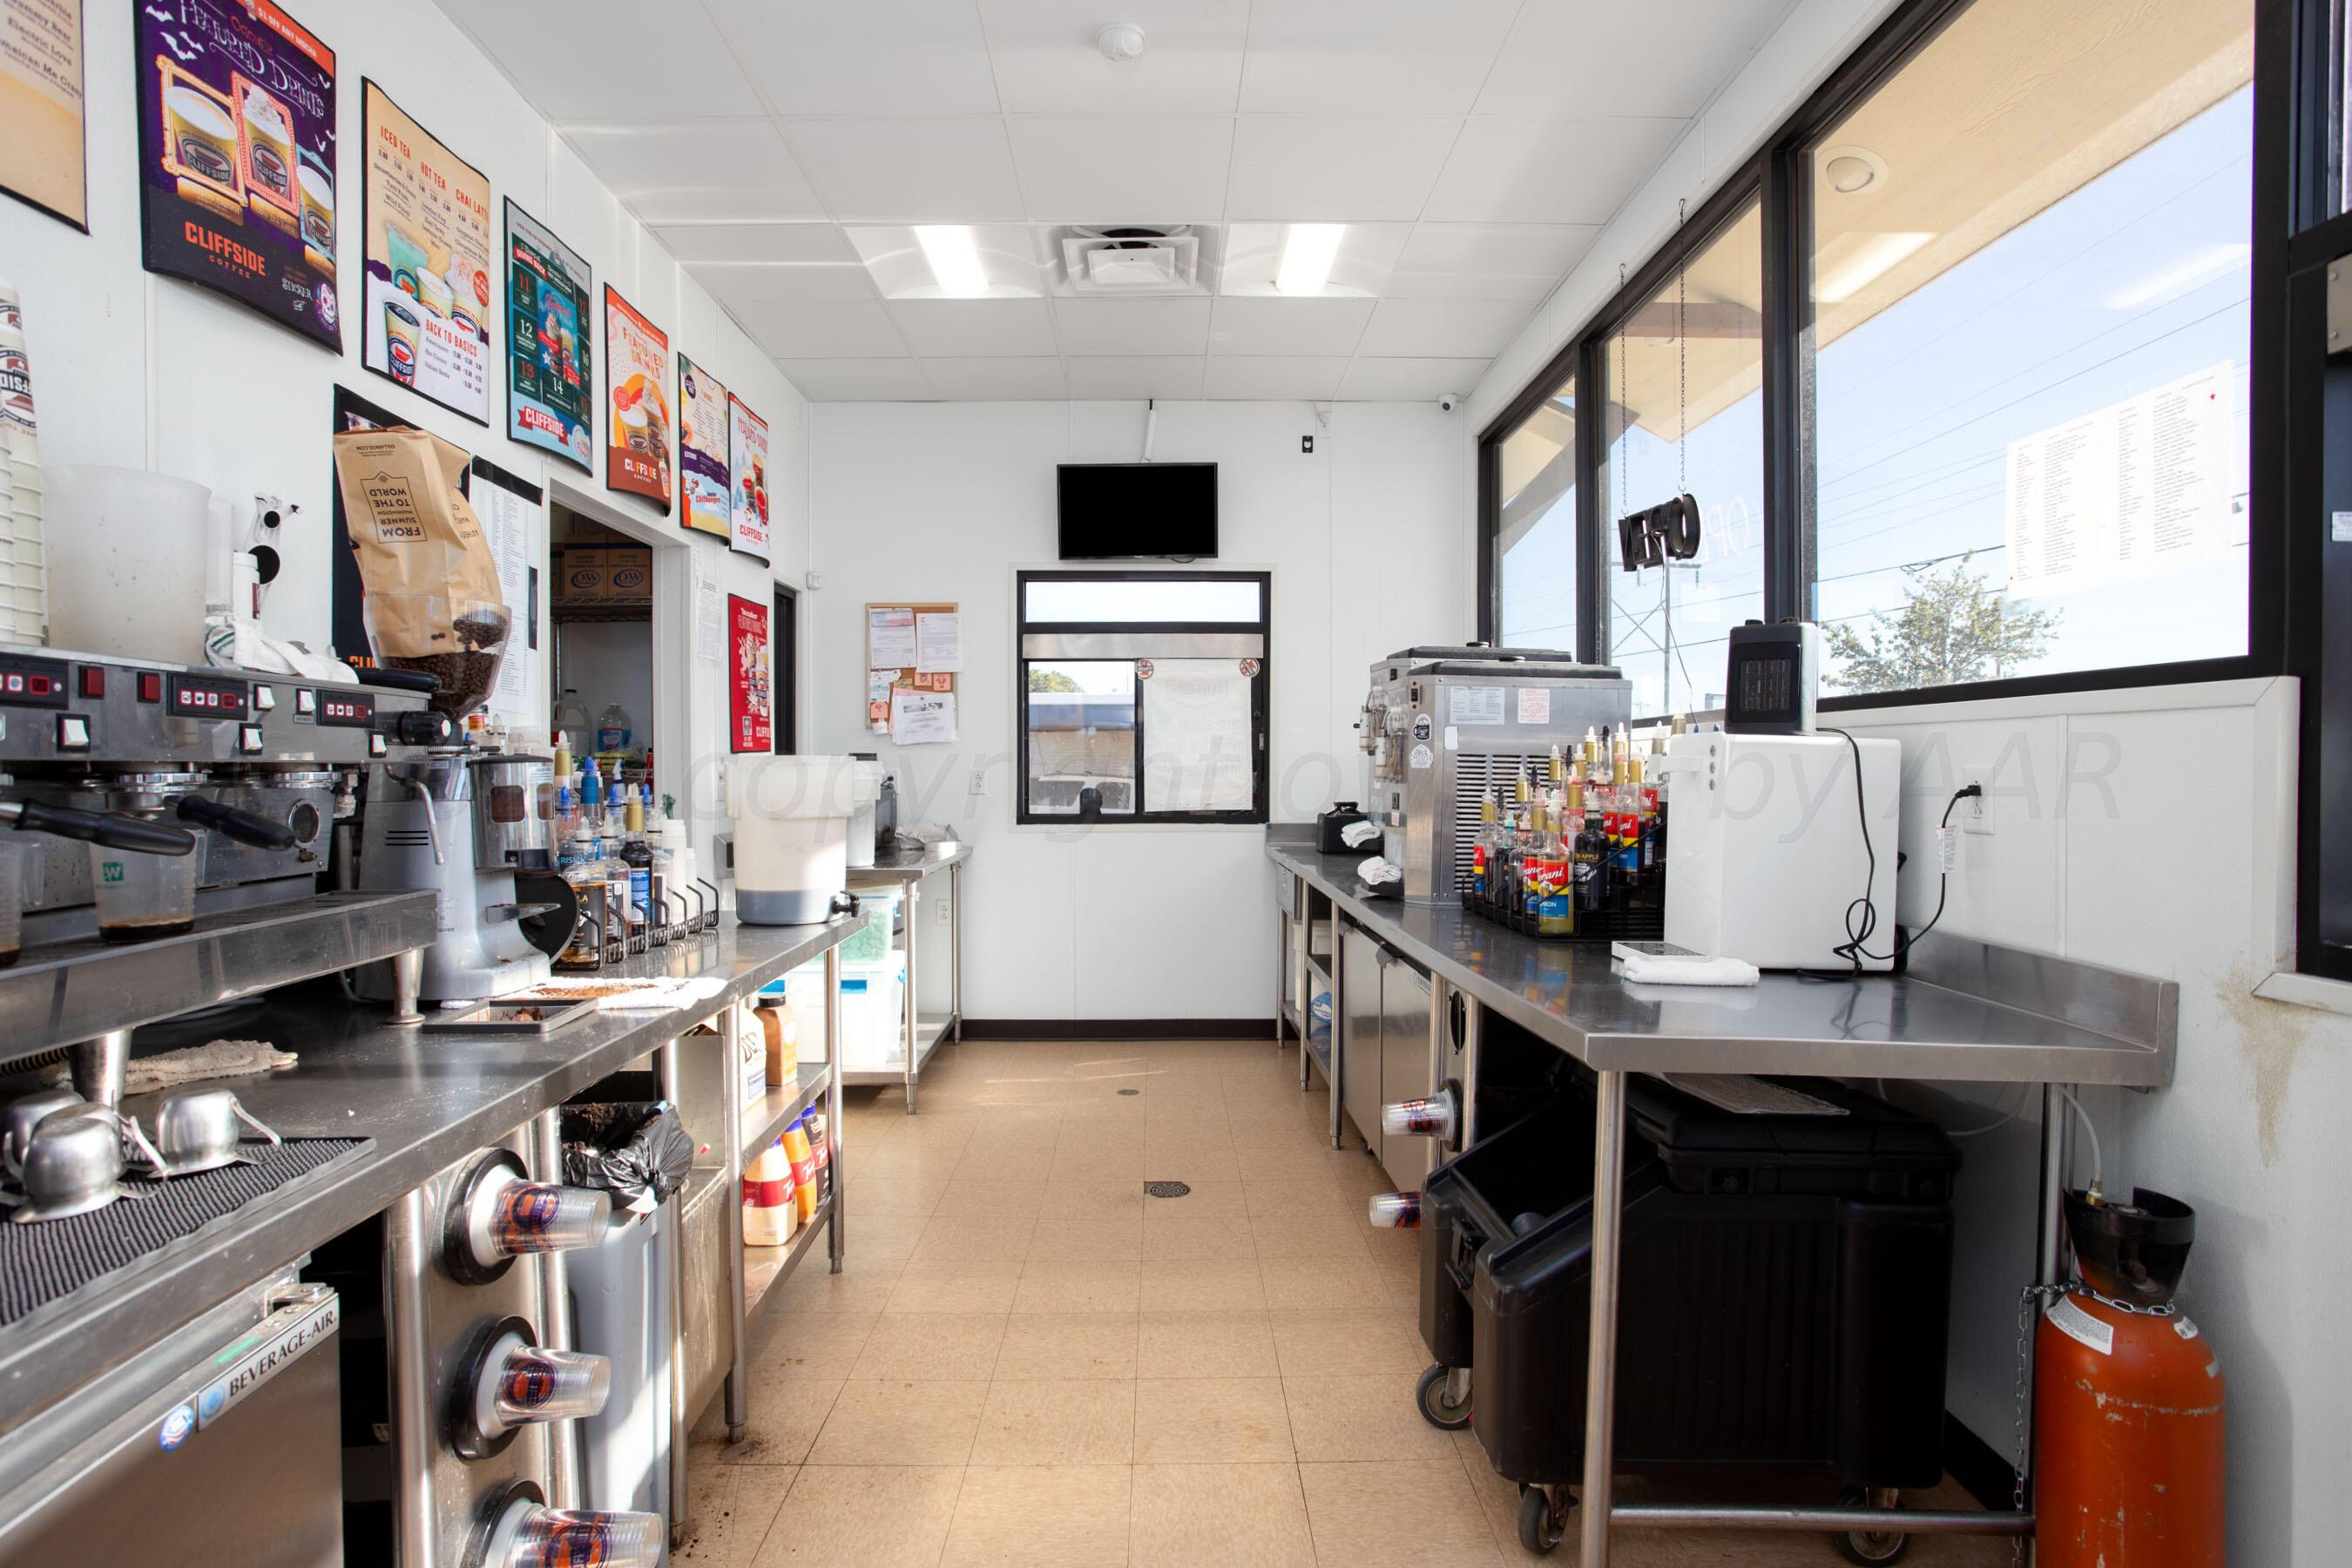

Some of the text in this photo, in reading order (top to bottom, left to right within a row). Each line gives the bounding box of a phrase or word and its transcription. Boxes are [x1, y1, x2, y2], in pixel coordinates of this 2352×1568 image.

[0, 39, 40, 69] amaican
[380, 125, 411, 160] ICED TEA
[420, 161, 447, 191] HOT TEA
[456, 188, 472, 209] CHAI
[185, 221, 266, 277] CLIFFSIDE
[209, 254, 251, 280] COFFEE
[519, 273, 531, 294] 11
[425, 318, 477, 358] BACK TO BASICS
[520, 319, 533, 339] 12
[521, 360, 535, 380] 13
[552, 376, 564, 395] 14
[525, 407, 564, 437] CLIFFSIDE
[625, 458, 657, 480] CLIFFSIDE
[369, 488, 407, 497] WORLD
[374, 498, 410, 508] TO THE
[382, 526, 422, 537] FROM
[740, 524, 763, 542] CLIFFSIDE
[230, 1310, 335, 1397] BEVERAGE-AIR
